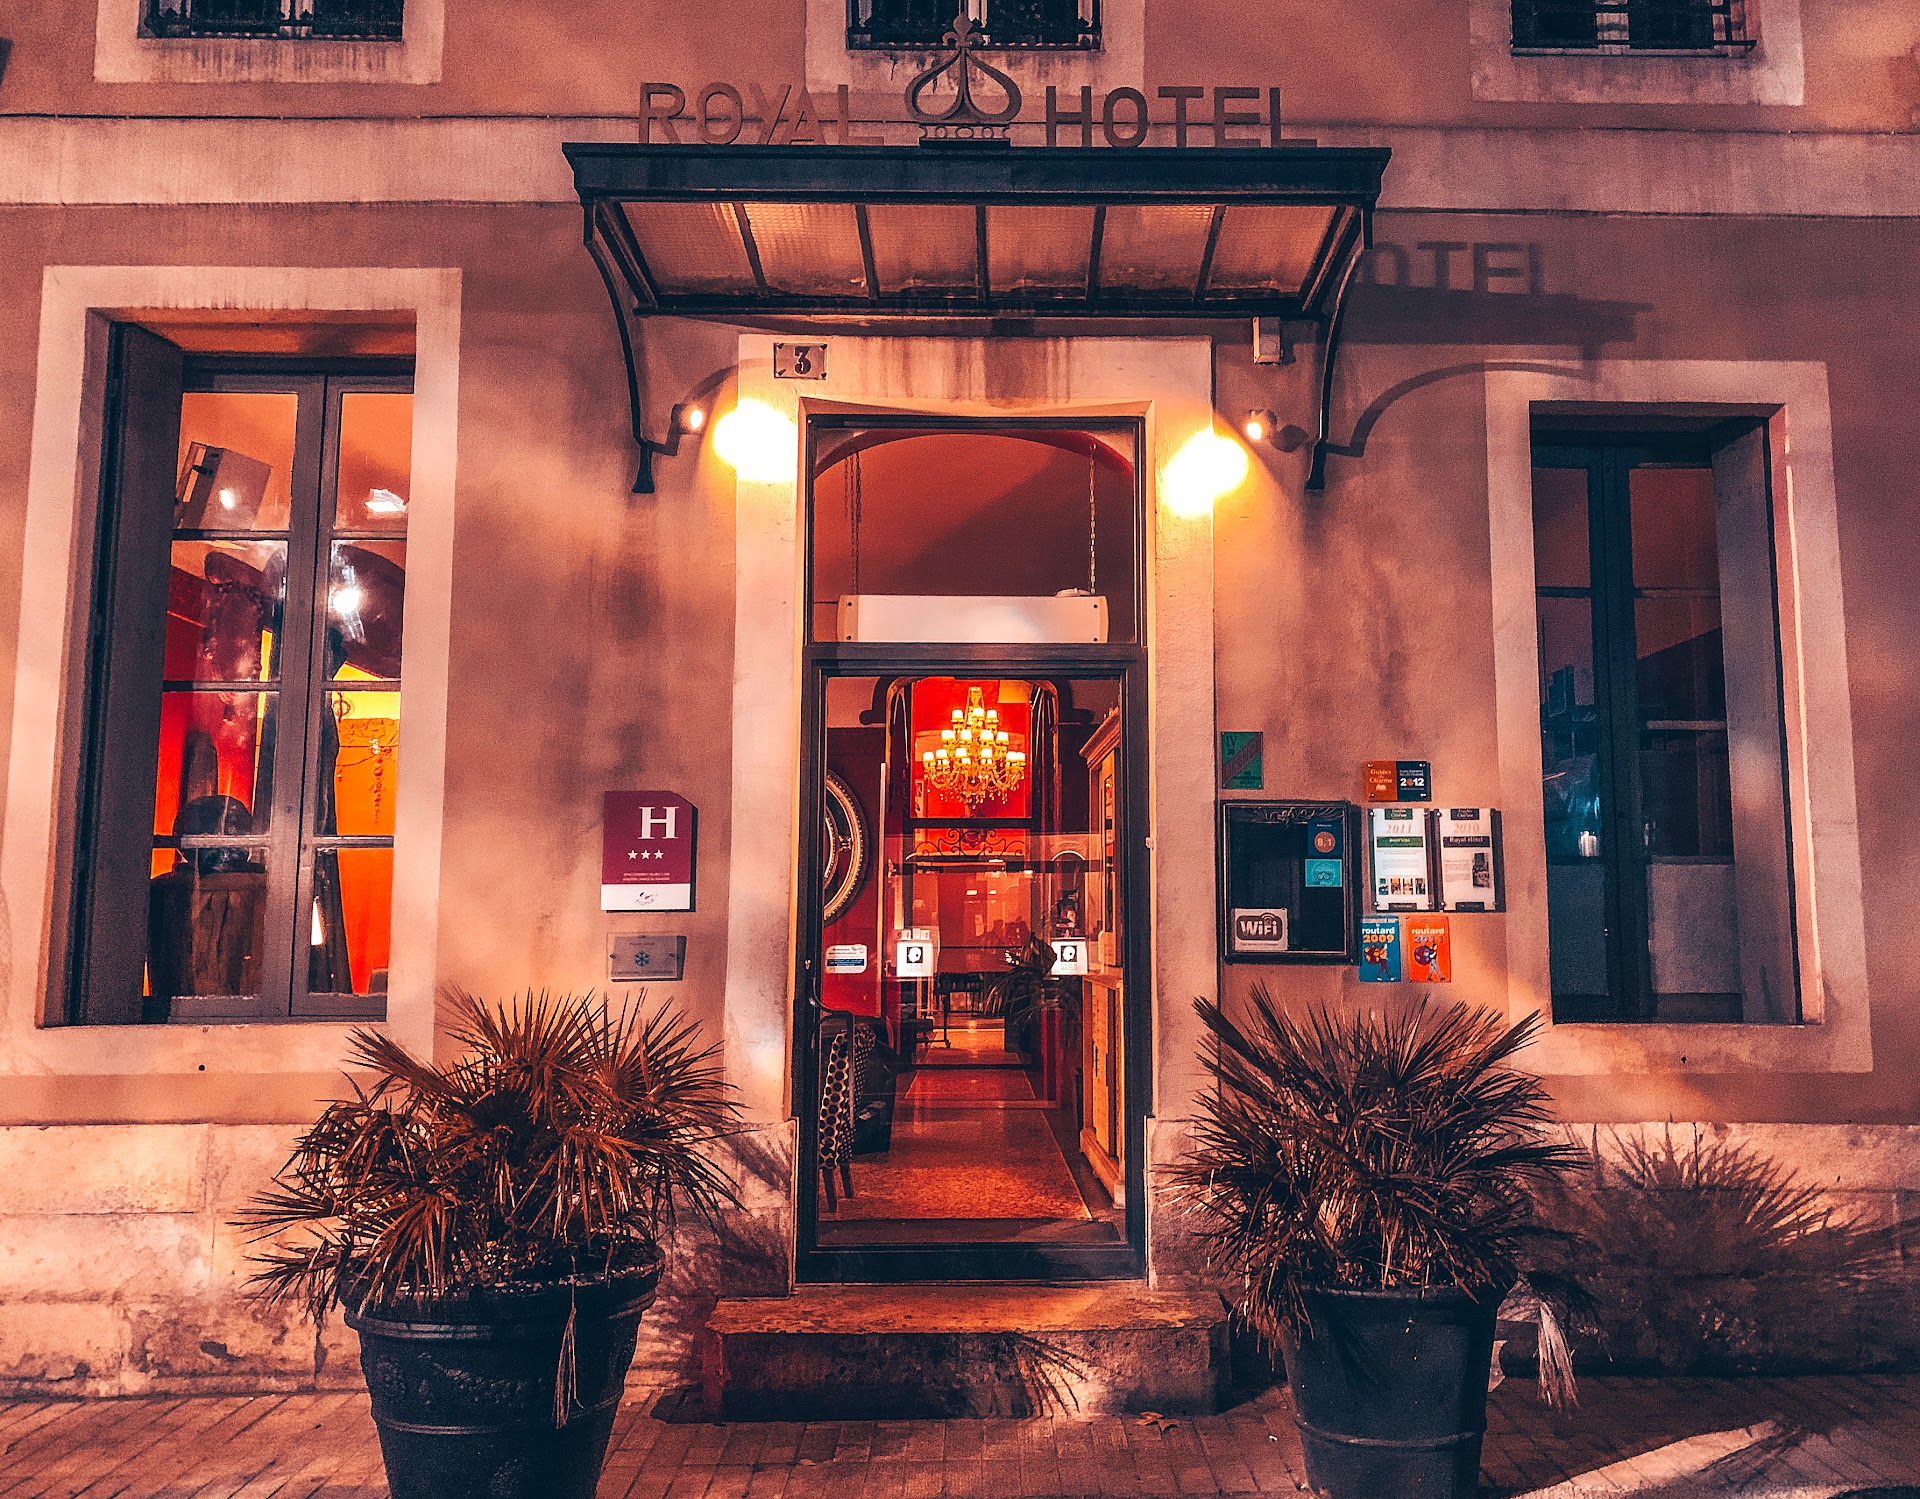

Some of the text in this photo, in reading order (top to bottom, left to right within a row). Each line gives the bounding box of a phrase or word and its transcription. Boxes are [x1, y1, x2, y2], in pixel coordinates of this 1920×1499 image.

[638, 82, 1318, 148] ROYAL HOTEL
[794, 345, 811, 375] 3
[637, 806, 680, 840] H
[1386, 823, 1413, 835] 2011
[1361, 926, 1396, 935] routard
[1411, 926, 1445, 935] routard
[1363, 934, 1395, 943] 2009
